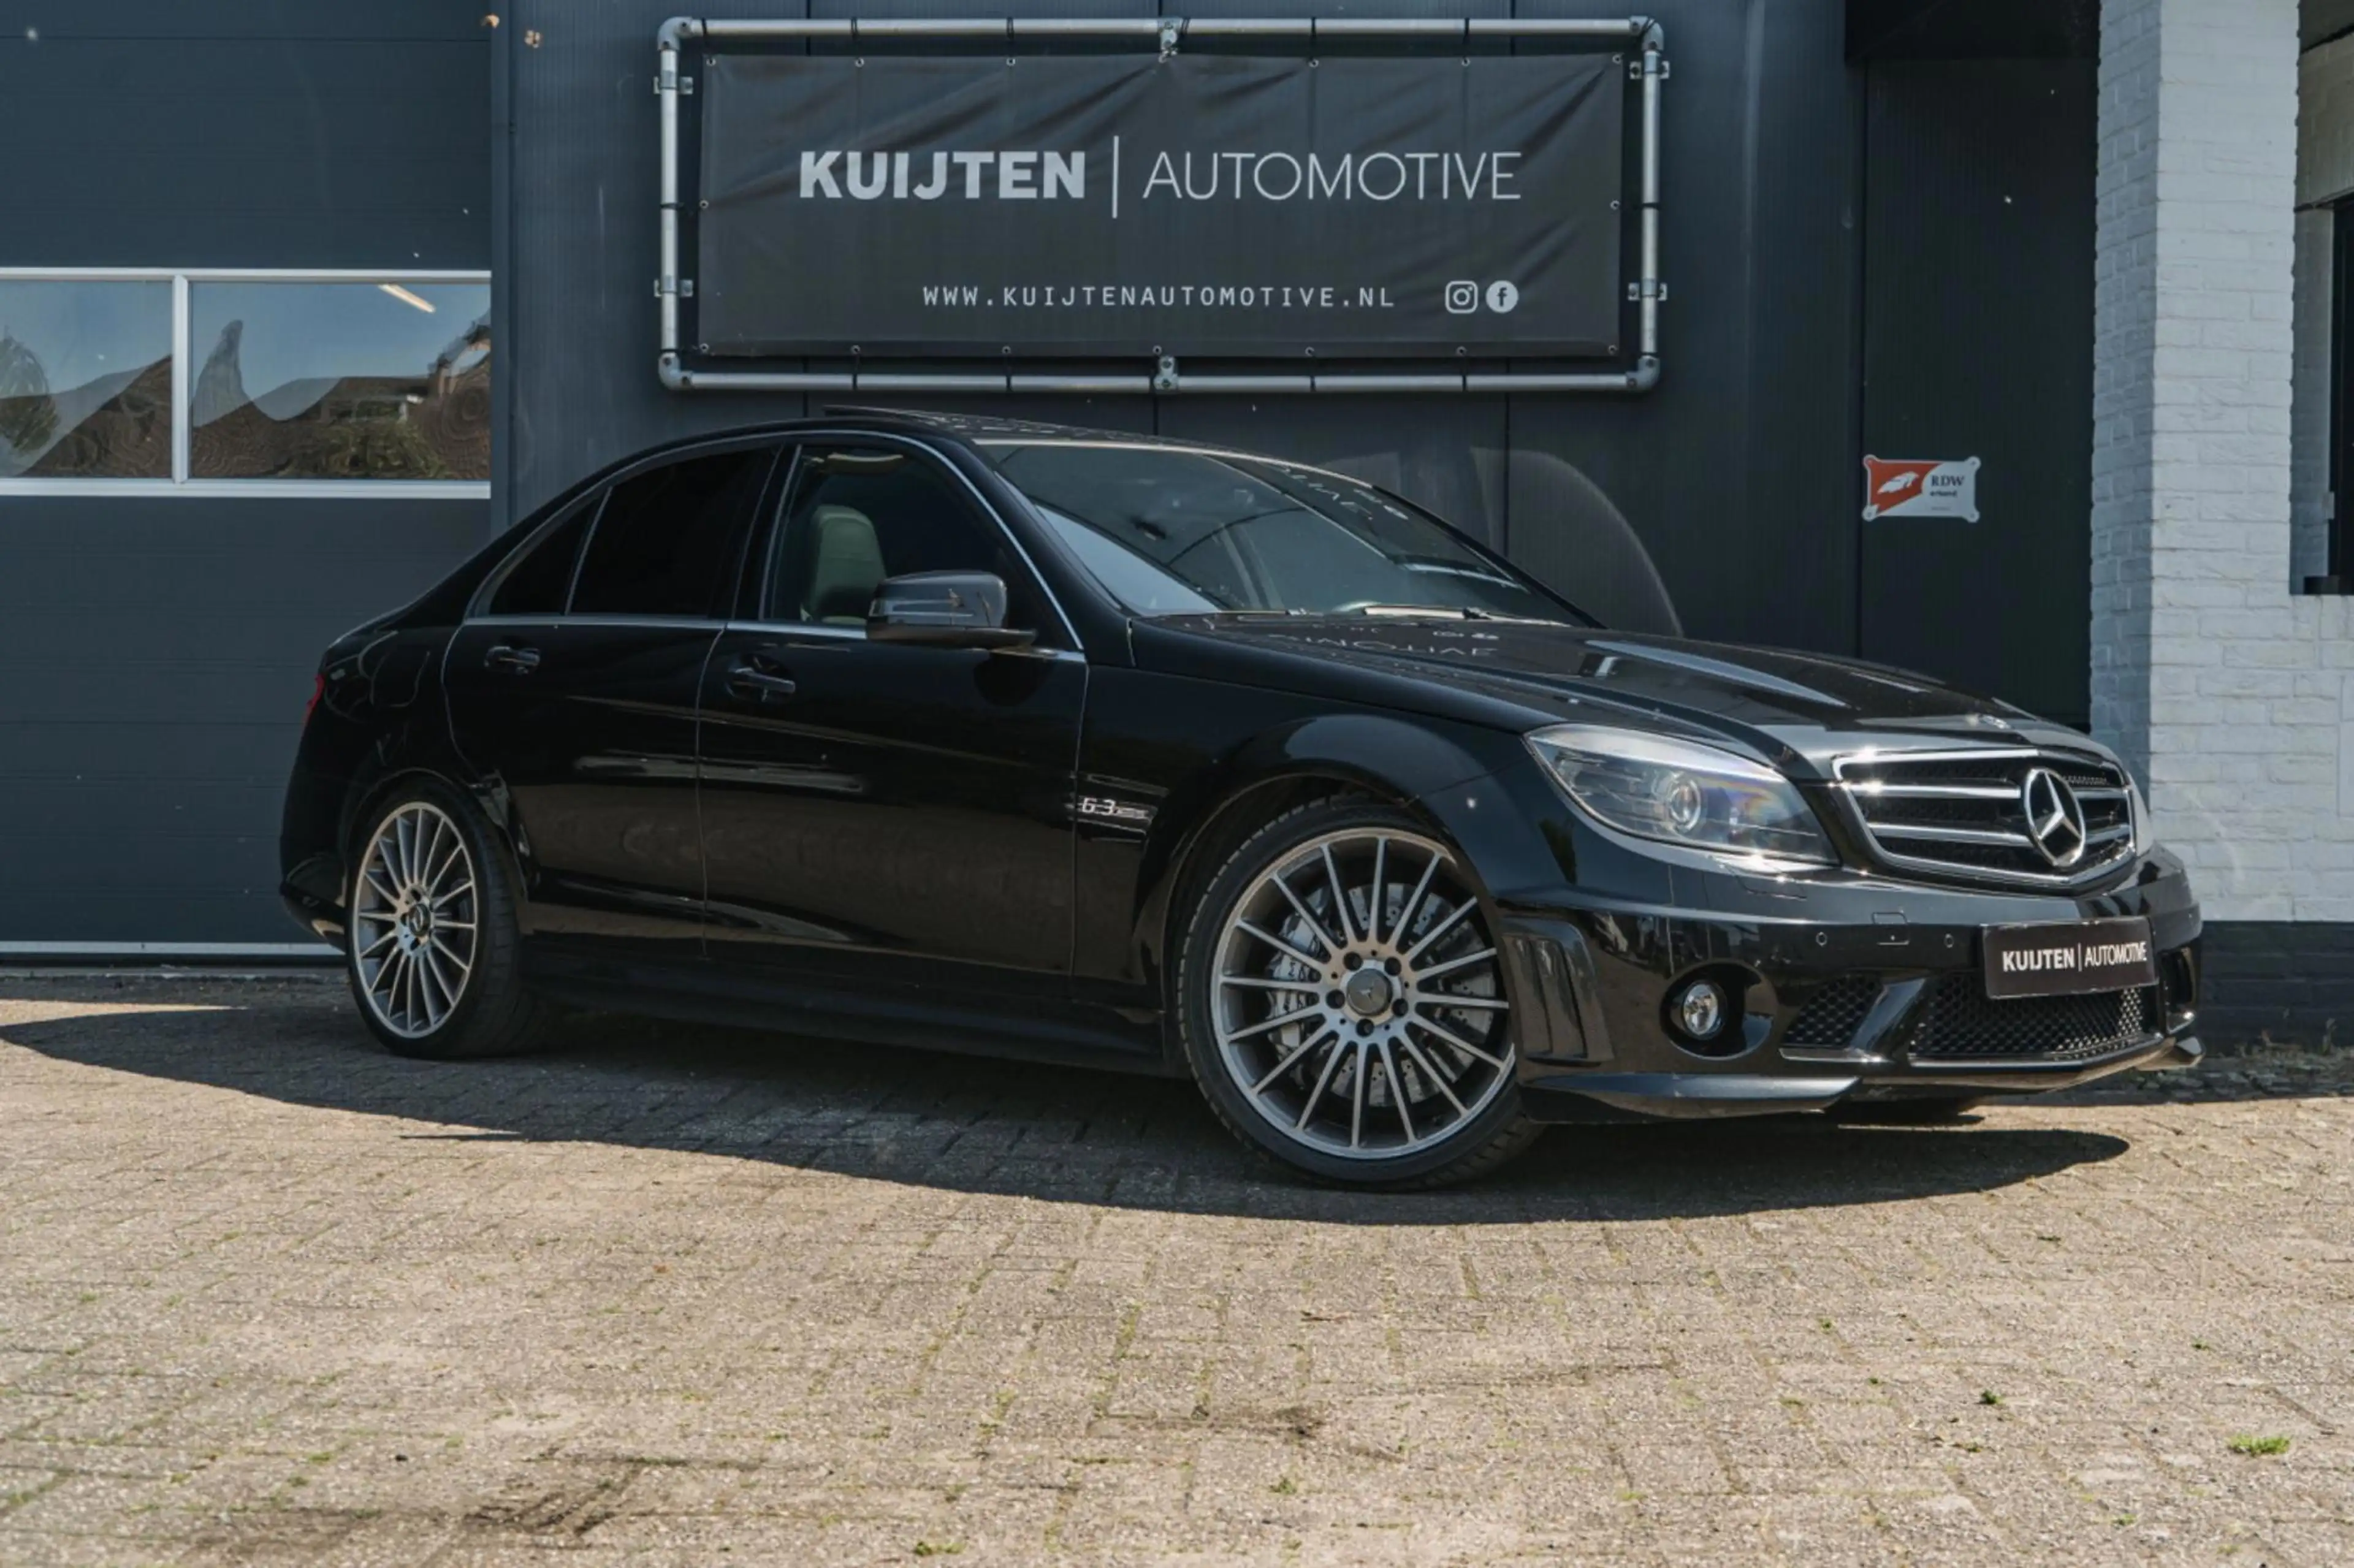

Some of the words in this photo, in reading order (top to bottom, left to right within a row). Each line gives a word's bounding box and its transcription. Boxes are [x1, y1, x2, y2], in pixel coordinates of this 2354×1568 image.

[799, 150, 1086, 200] KUIJTEN
[1143, 151, 1522, 200] AUTOMOTIVE
[923, 286, 1395, 308] WWW.KUIJTENAUTOMOTIVE.NL
[1930, 474, 1965, 487] RDW
[2002, 947, 2075, 972] KUIJTEN
[2084, 940, 2148, 968] AUTOMOTIVE
